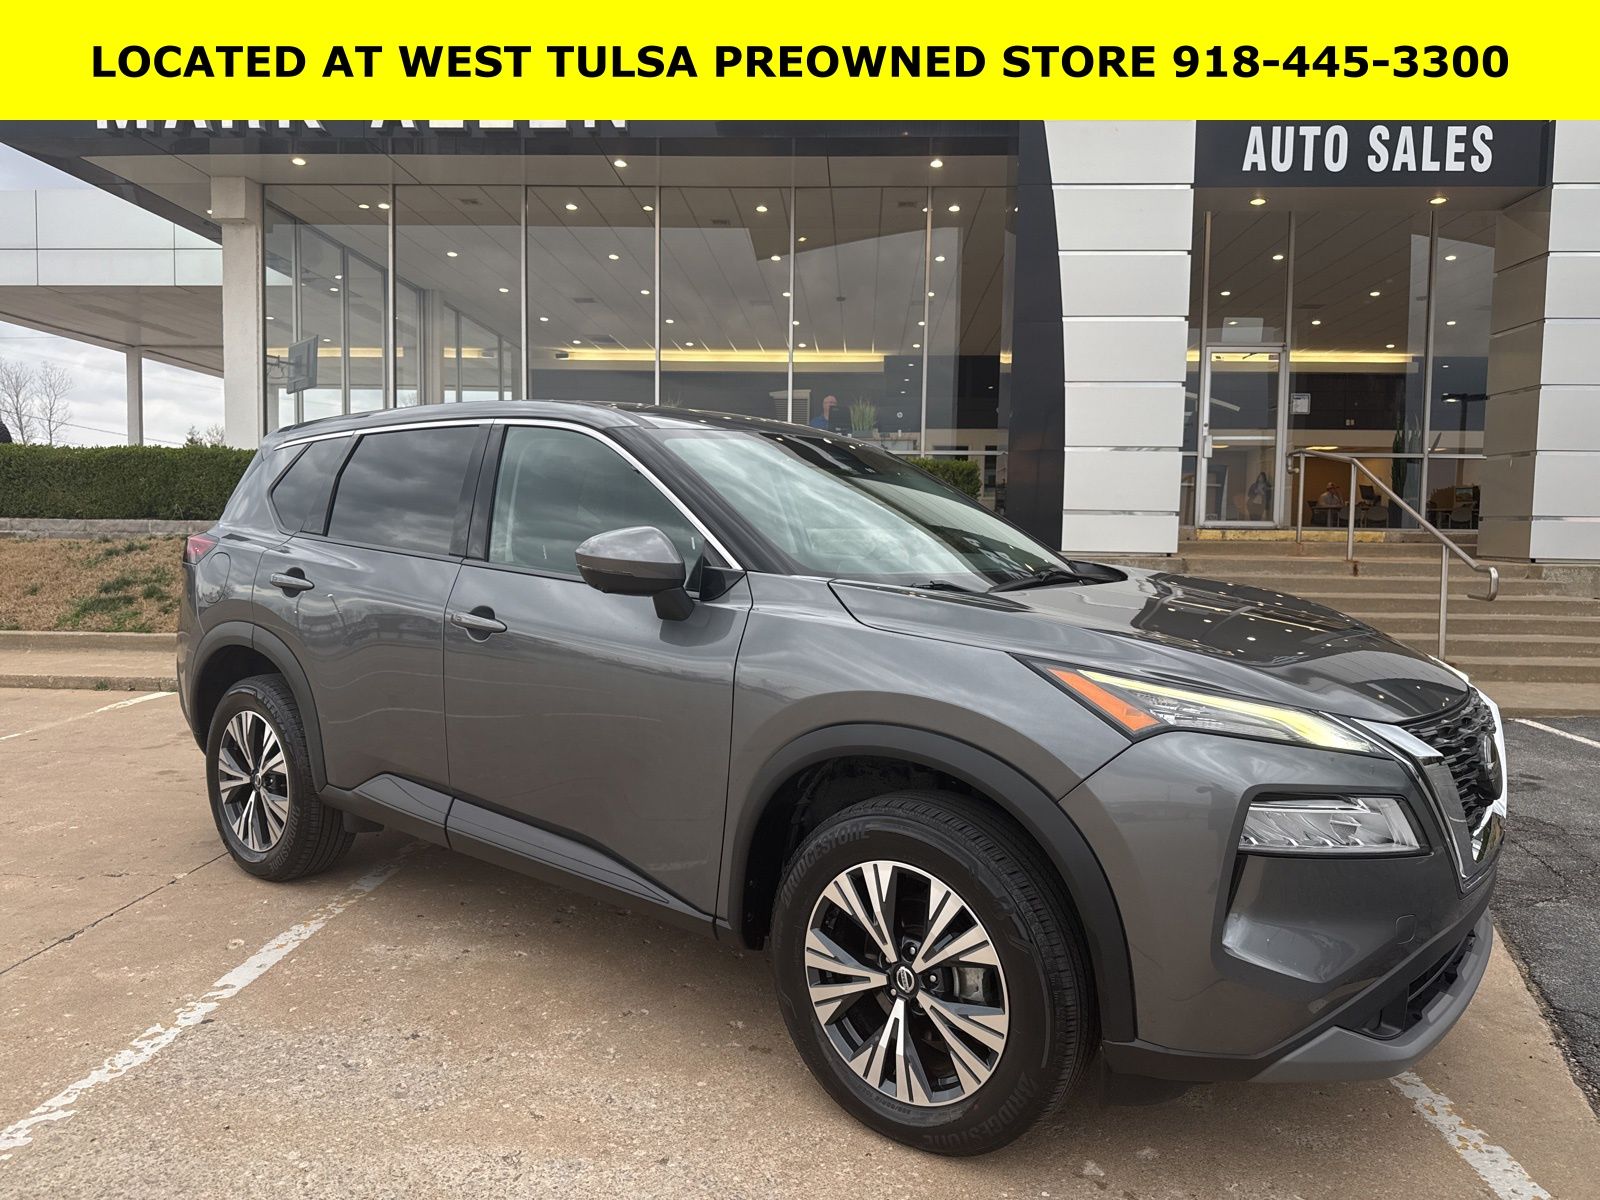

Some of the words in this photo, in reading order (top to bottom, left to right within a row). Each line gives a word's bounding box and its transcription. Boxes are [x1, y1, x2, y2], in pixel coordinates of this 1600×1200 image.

[1242, 125, 1349, 173] AUTO
[1367, 125, 1494, 173] SALES
[781, 823, 871, 906] BRIDGESTONE
[924, 1074, 1037, 1148] BRIDGESTONE
